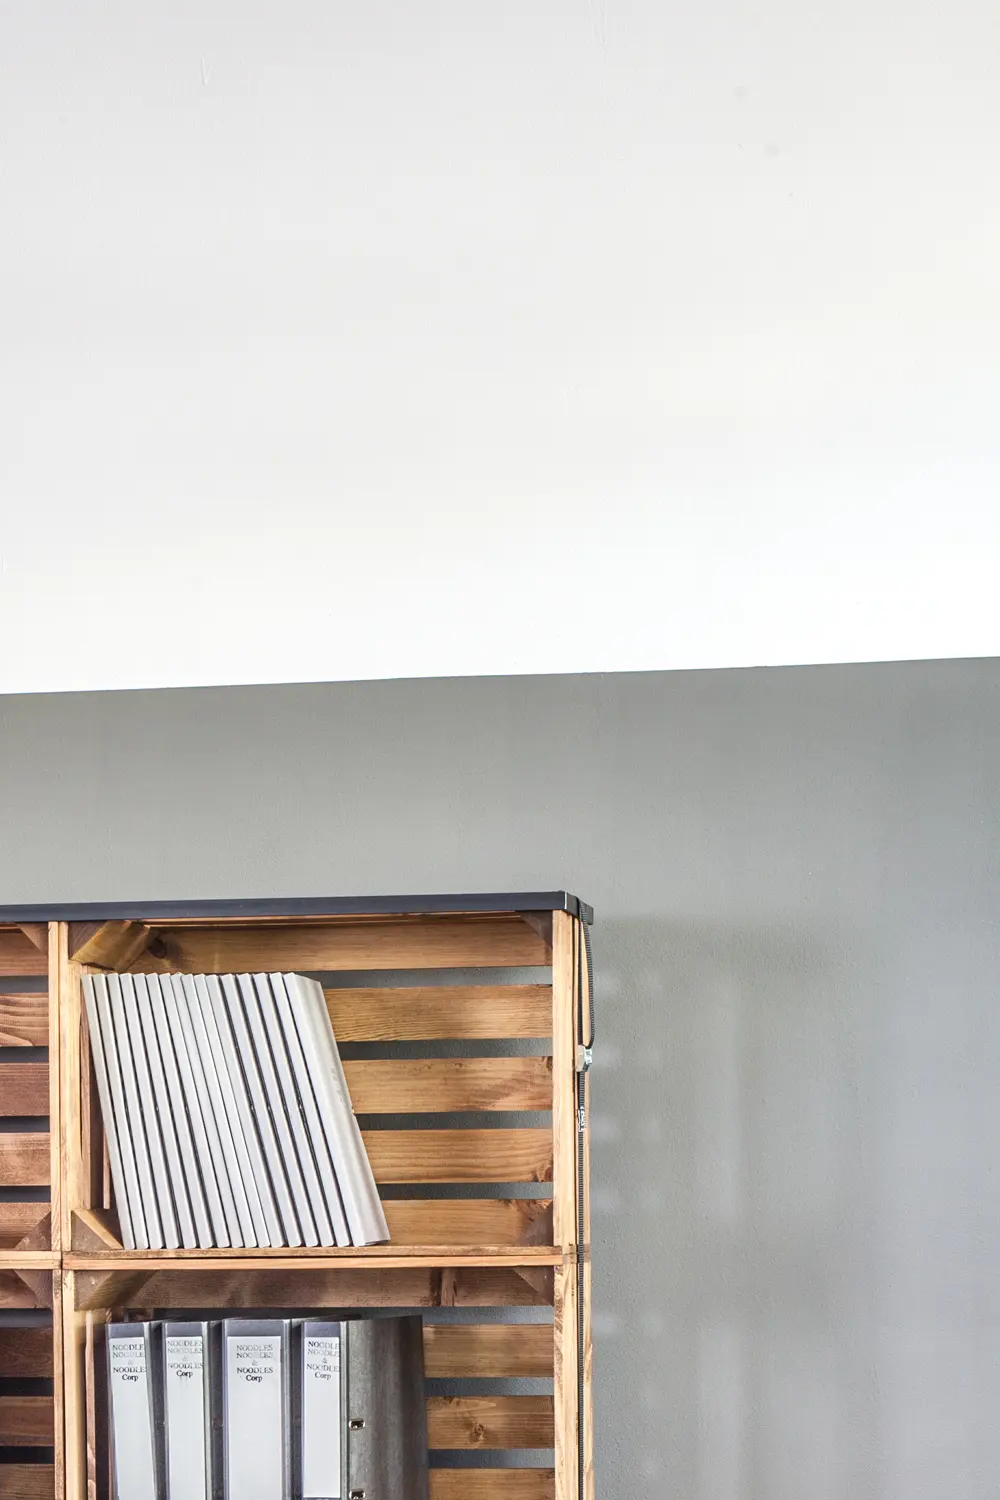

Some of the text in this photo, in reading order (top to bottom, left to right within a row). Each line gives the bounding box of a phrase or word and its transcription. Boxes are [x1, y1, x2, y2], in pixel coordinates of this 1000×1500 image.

[308, 1341, 340, 1349] NOODLE
[307, 1348, 340, 1357] NOODLE
[306, 1364, 340, 1372] NOODLE
[121, 1374, 139, 1382] Corp
[176, 1370, 193, 1378] Corp
[314, 1372, 332, 1380] Corp
[245, 1375, 263, 1383] Corp
